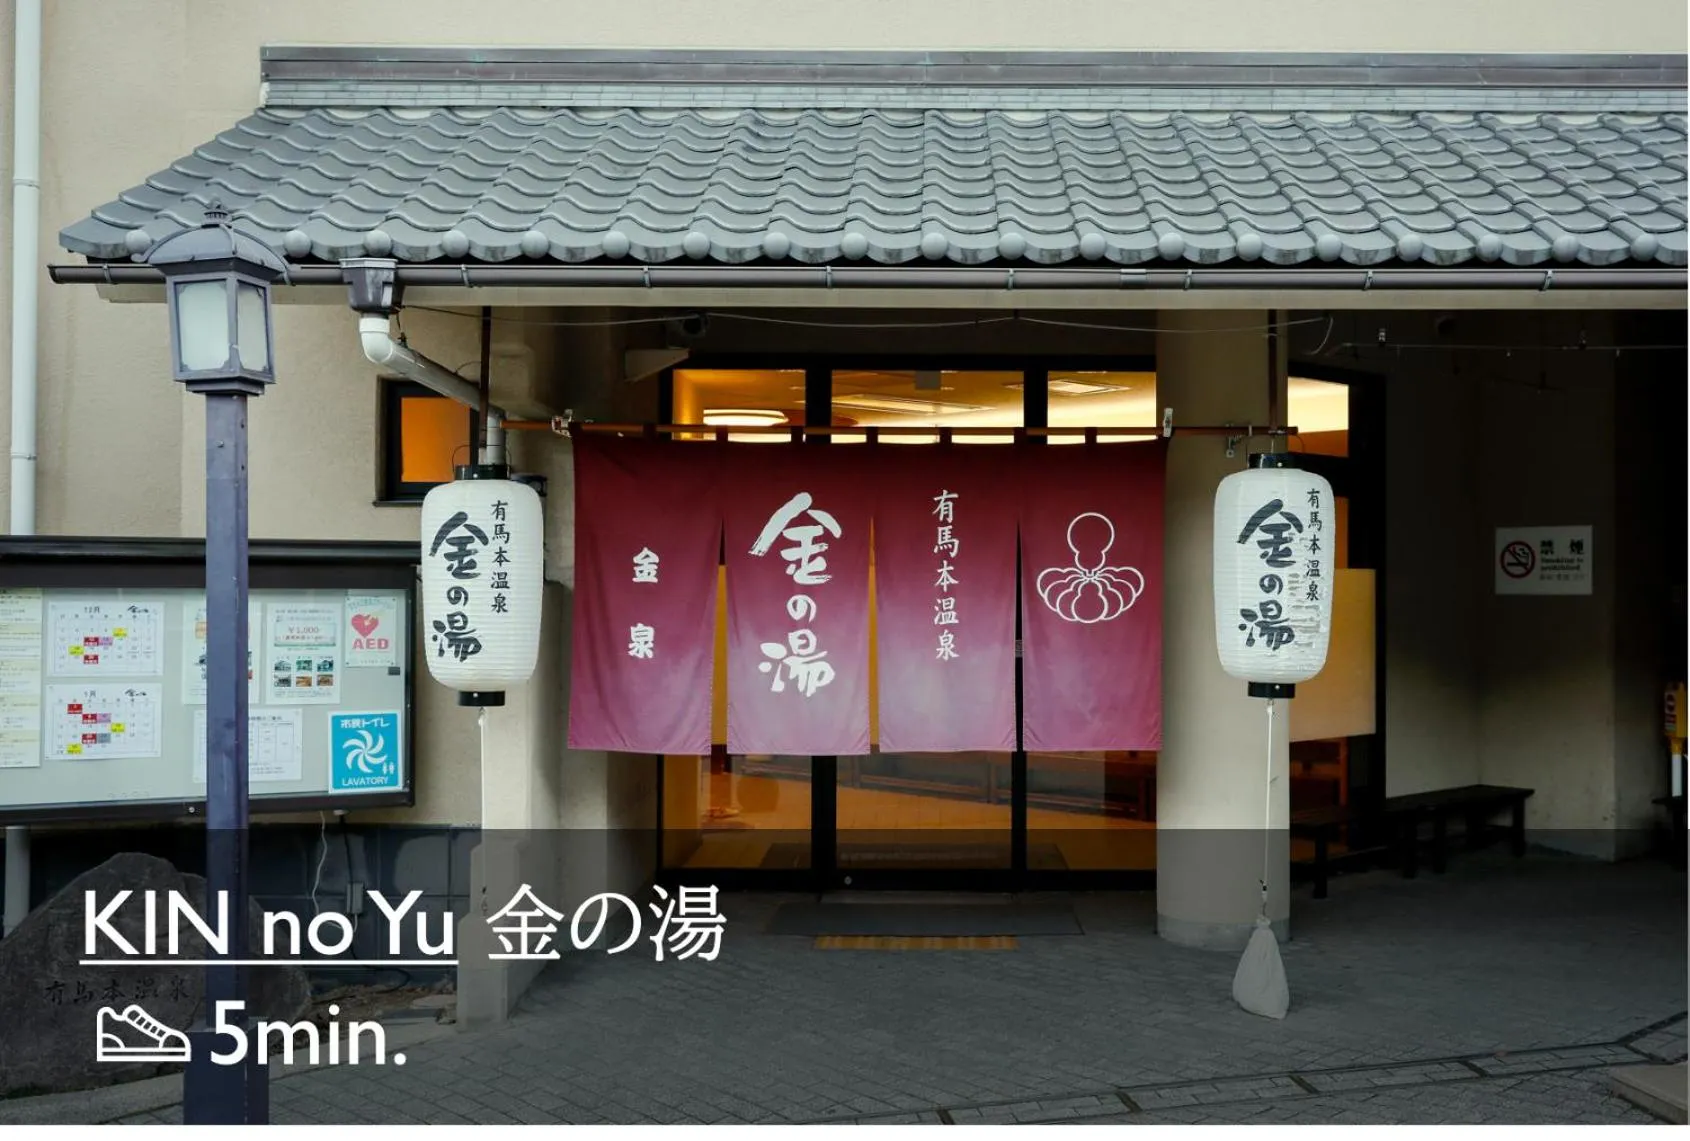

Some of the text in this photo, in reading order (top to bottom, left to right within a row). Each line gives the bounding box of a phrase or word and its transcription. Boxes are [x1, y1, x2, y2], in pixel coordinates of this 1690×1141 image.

[429, 511, 489, 663] 金の湯
[490, 500, 511, 614] 有馬本温泉
[748, 492, 842, 698] 金の湯
[933, 489, 960, 661] 有馬本温泉
[1237, 499, 1304, 651] 金の湯
[1306, 488, 1322, 601] 有馬本温泉
[352, 638, 390, 650] AED
[342, 776, 389, 786] LAVATORY
